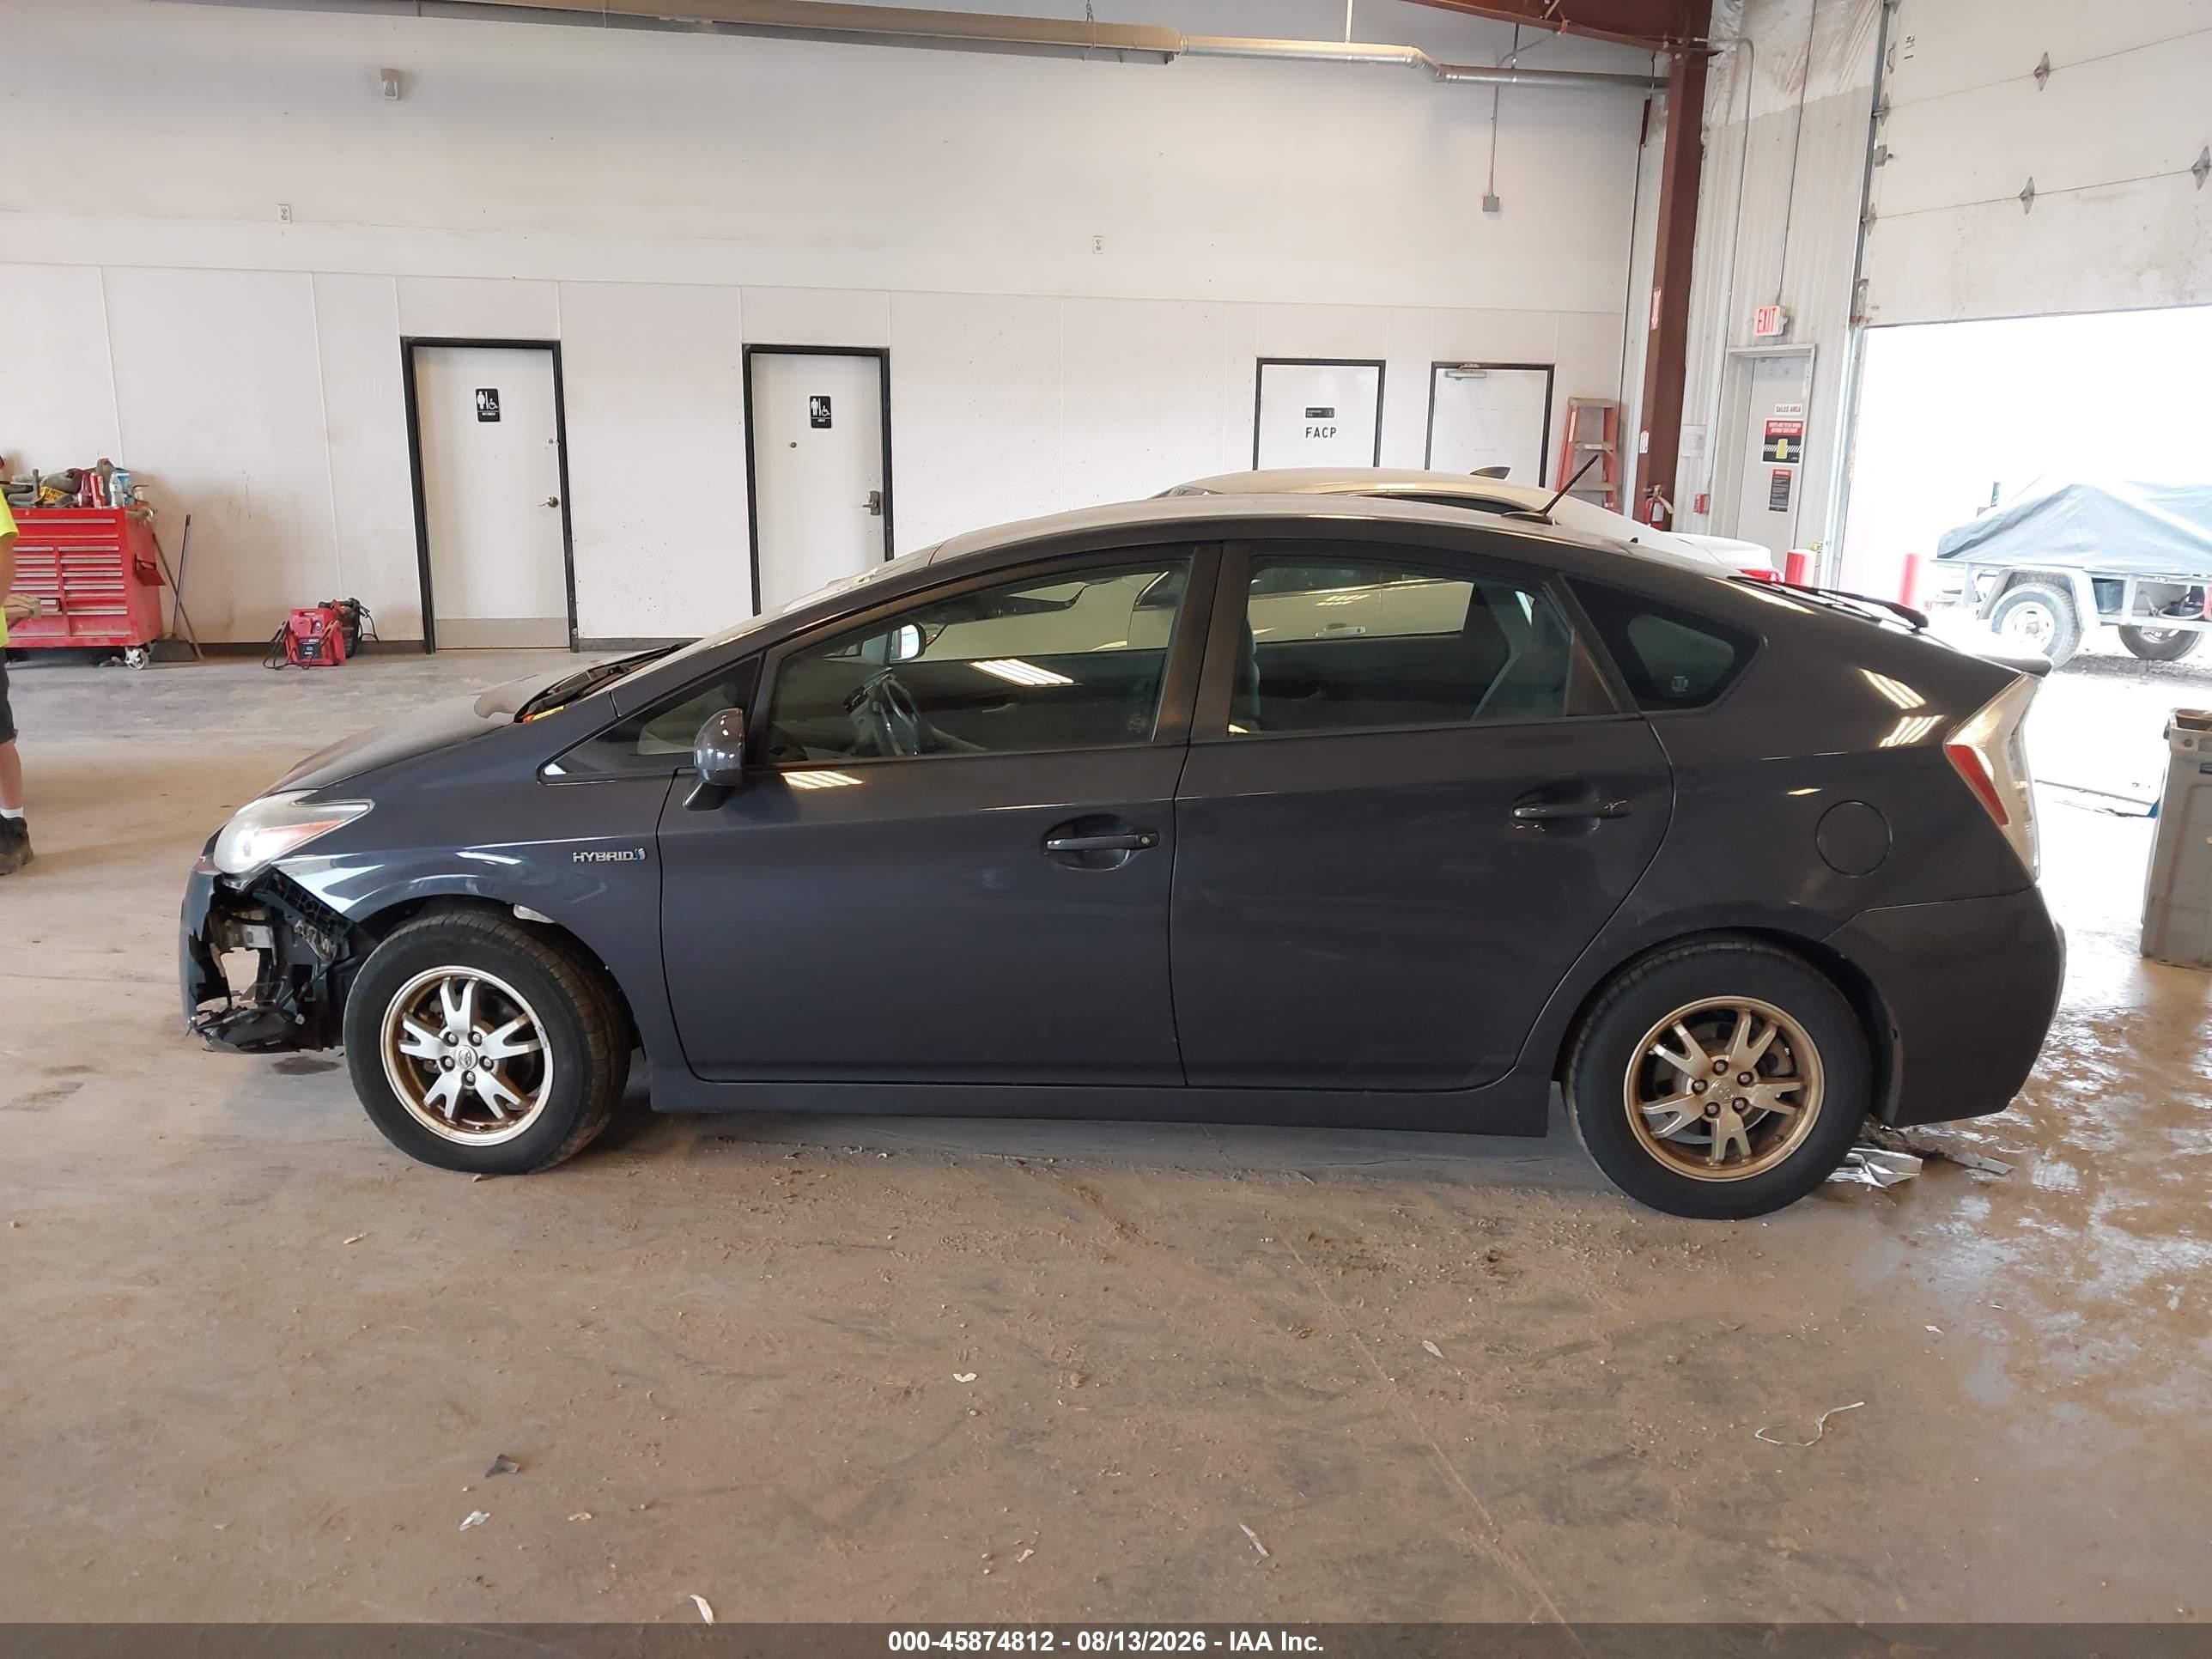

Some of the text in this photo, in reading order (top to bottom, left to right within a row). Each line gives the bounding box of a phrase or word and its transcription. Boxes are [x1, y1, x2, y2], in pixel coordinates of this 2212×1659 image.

[1757, 307, 1778, 334] EXIT
[1305, 426, 1337, 439] FACP
[572, 850, 634, 863] HYBRID
